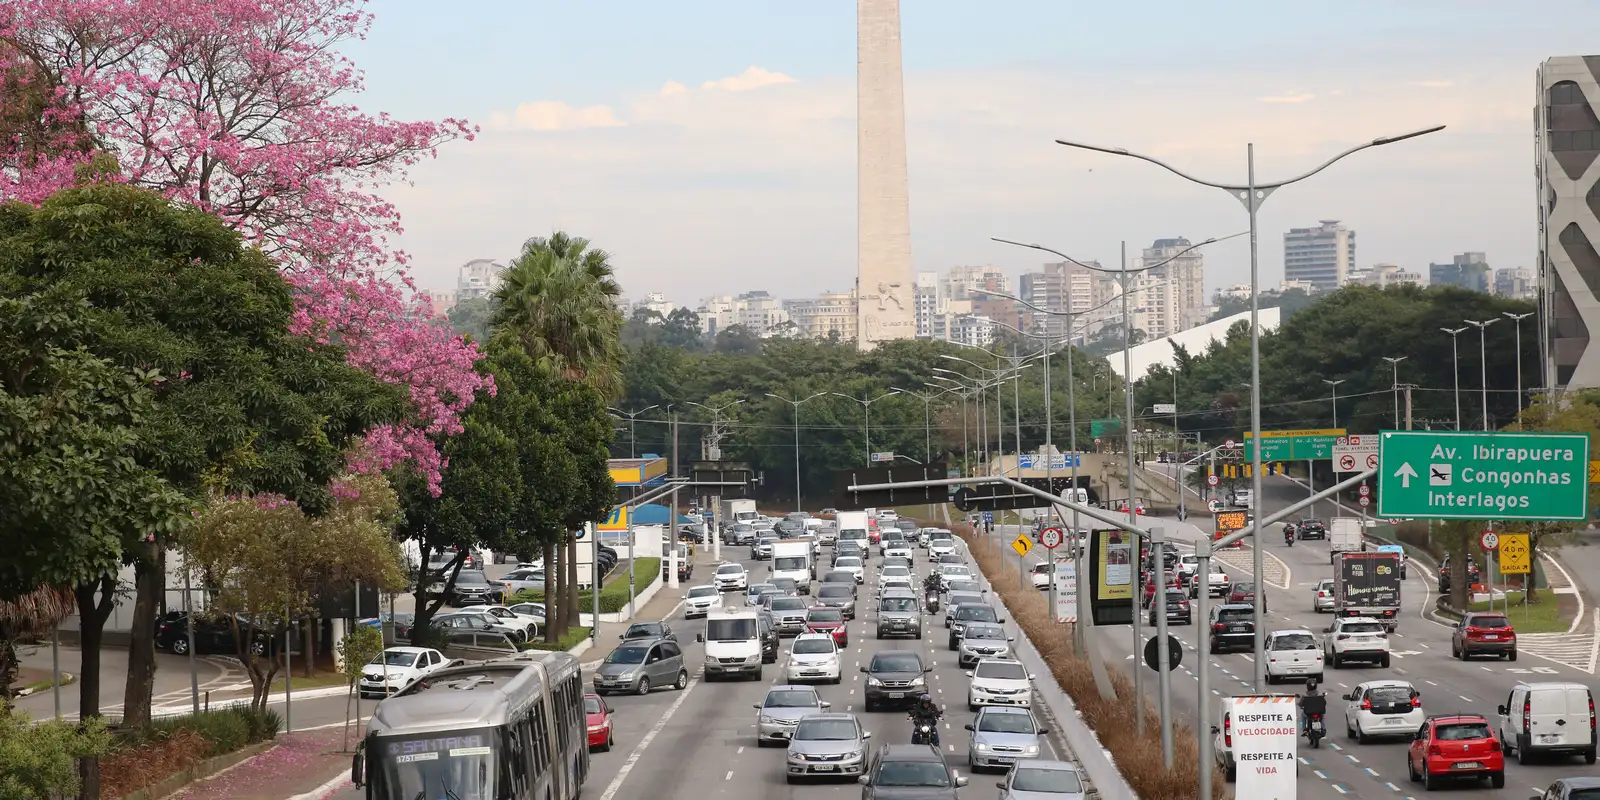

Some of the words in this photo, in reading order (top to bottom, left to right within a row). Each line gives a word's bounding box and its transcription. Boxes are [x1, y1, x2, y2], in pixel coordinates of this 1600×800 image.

[1430, 443, 1462, 460] Av.
[1473, 444, 1573, 463] Ibirapuera
[1461, 468, 1570, 488] Congonhas
[1428, 491, 1529, 511] Interlagos
[1239, 714, 1283, 722] RESPEITE
[1237, 728, 1295, 736] VELOCIDADE
[403, 735, 481, 753] SANTANA
[1241, 753, 1284, 761] RESPEITE
[1256, 766, 1277, 774] VIDA
